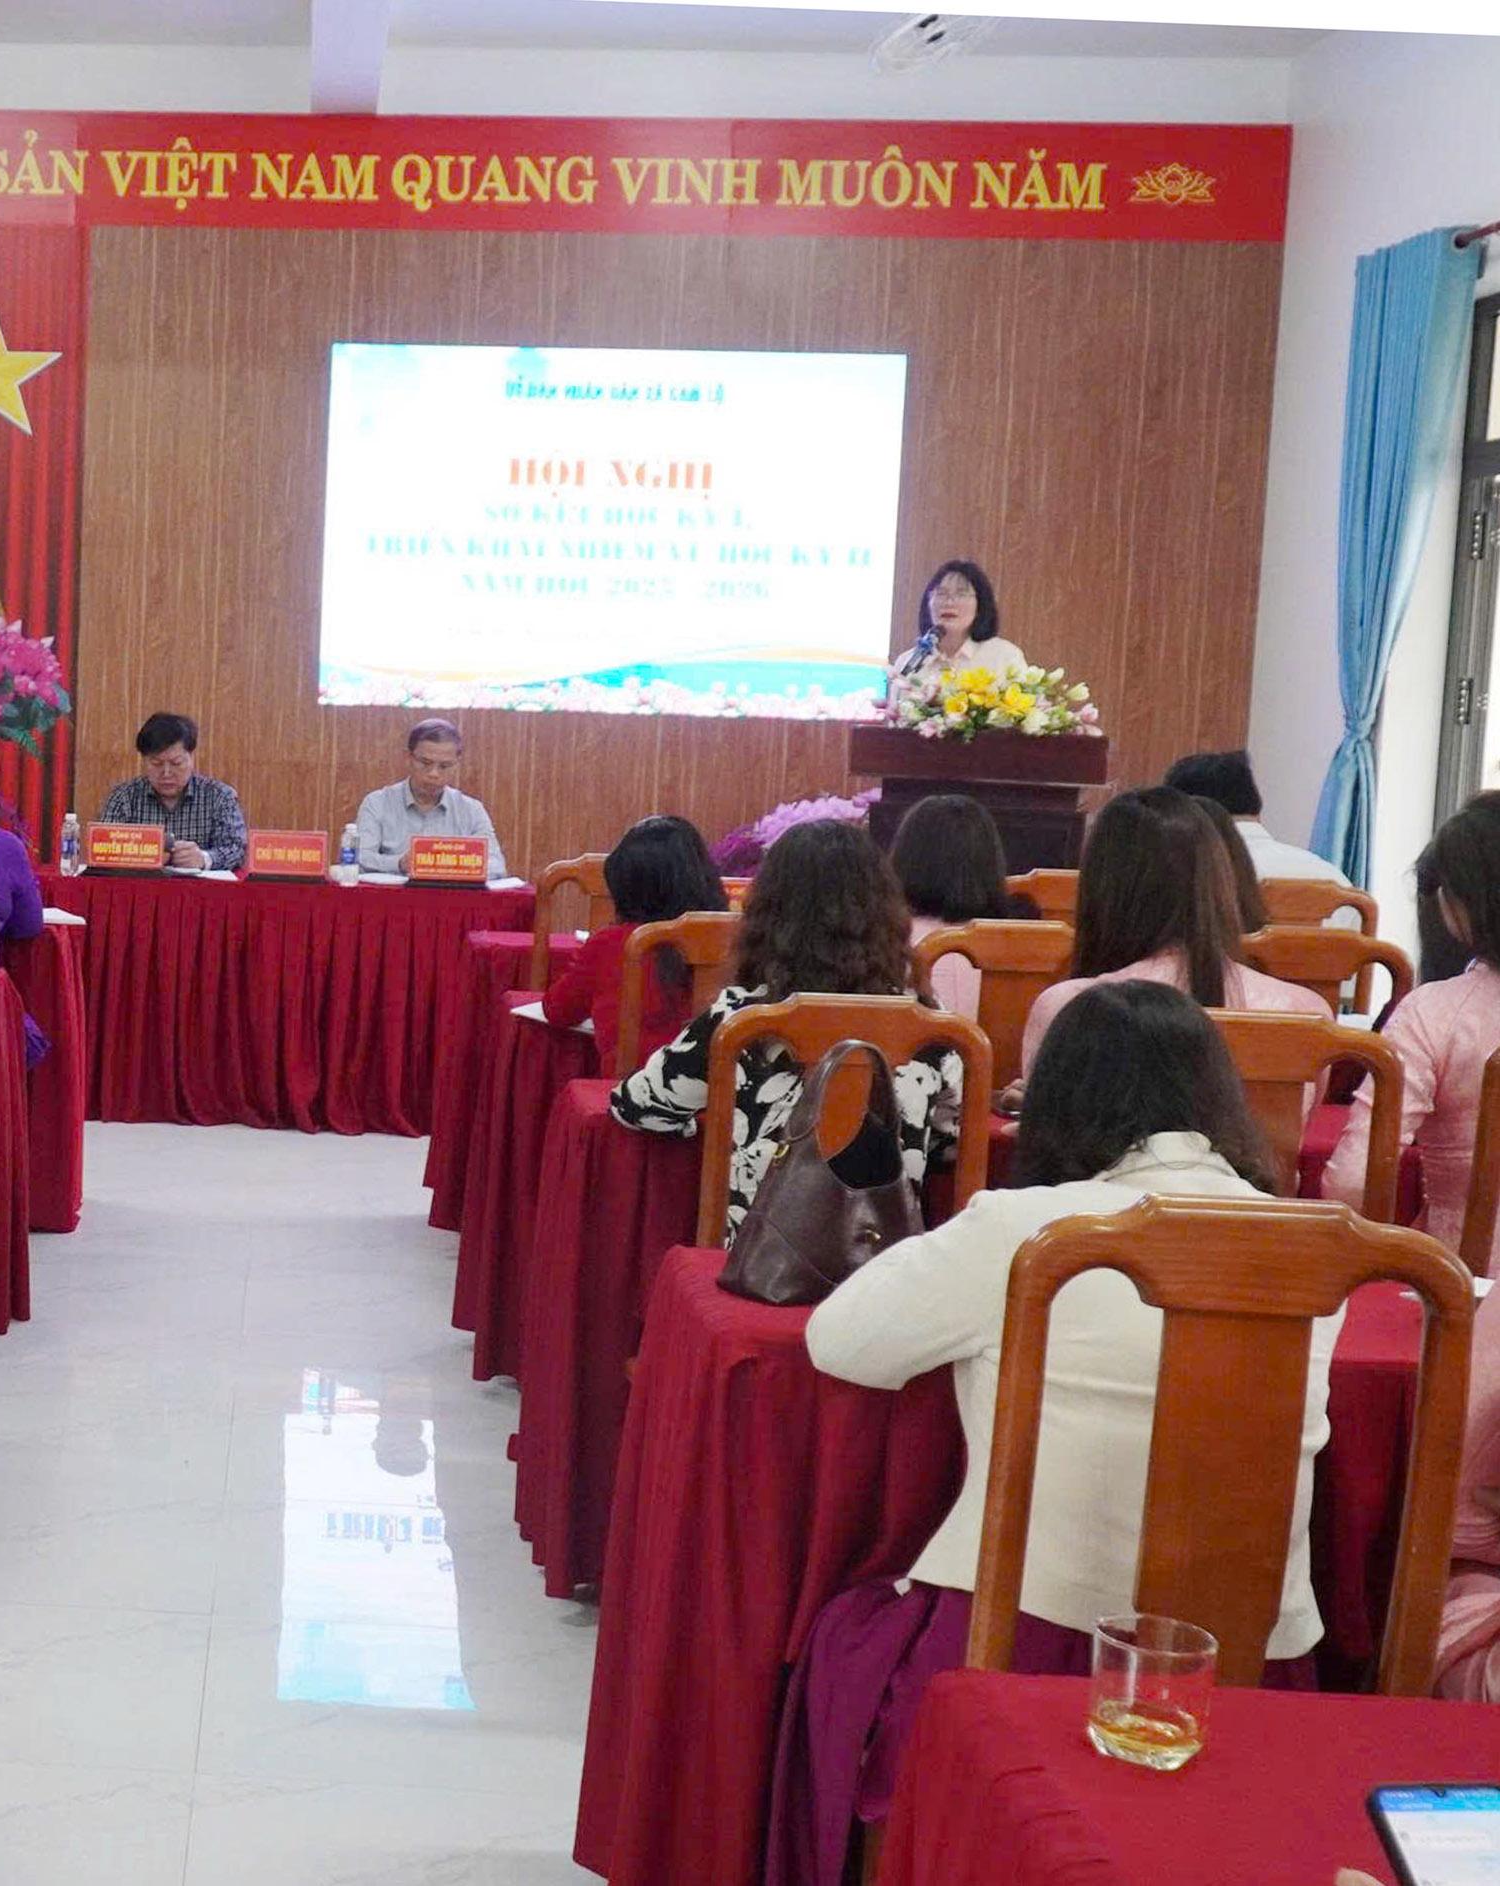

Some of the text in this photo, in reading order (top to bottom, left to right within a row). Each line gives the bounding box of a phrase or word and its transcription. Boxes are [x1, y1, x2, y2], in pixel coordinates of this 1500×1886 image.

[106, 138, 238, 210] VIỆT
[252, 154, 379, 202] NAM
[390, 153, 599, 209] QUANG
[611, 157, 758, 206] VINH
[775, 145, 960, 210] MUÔN
[970, 149, 1107, 211] NĂM
